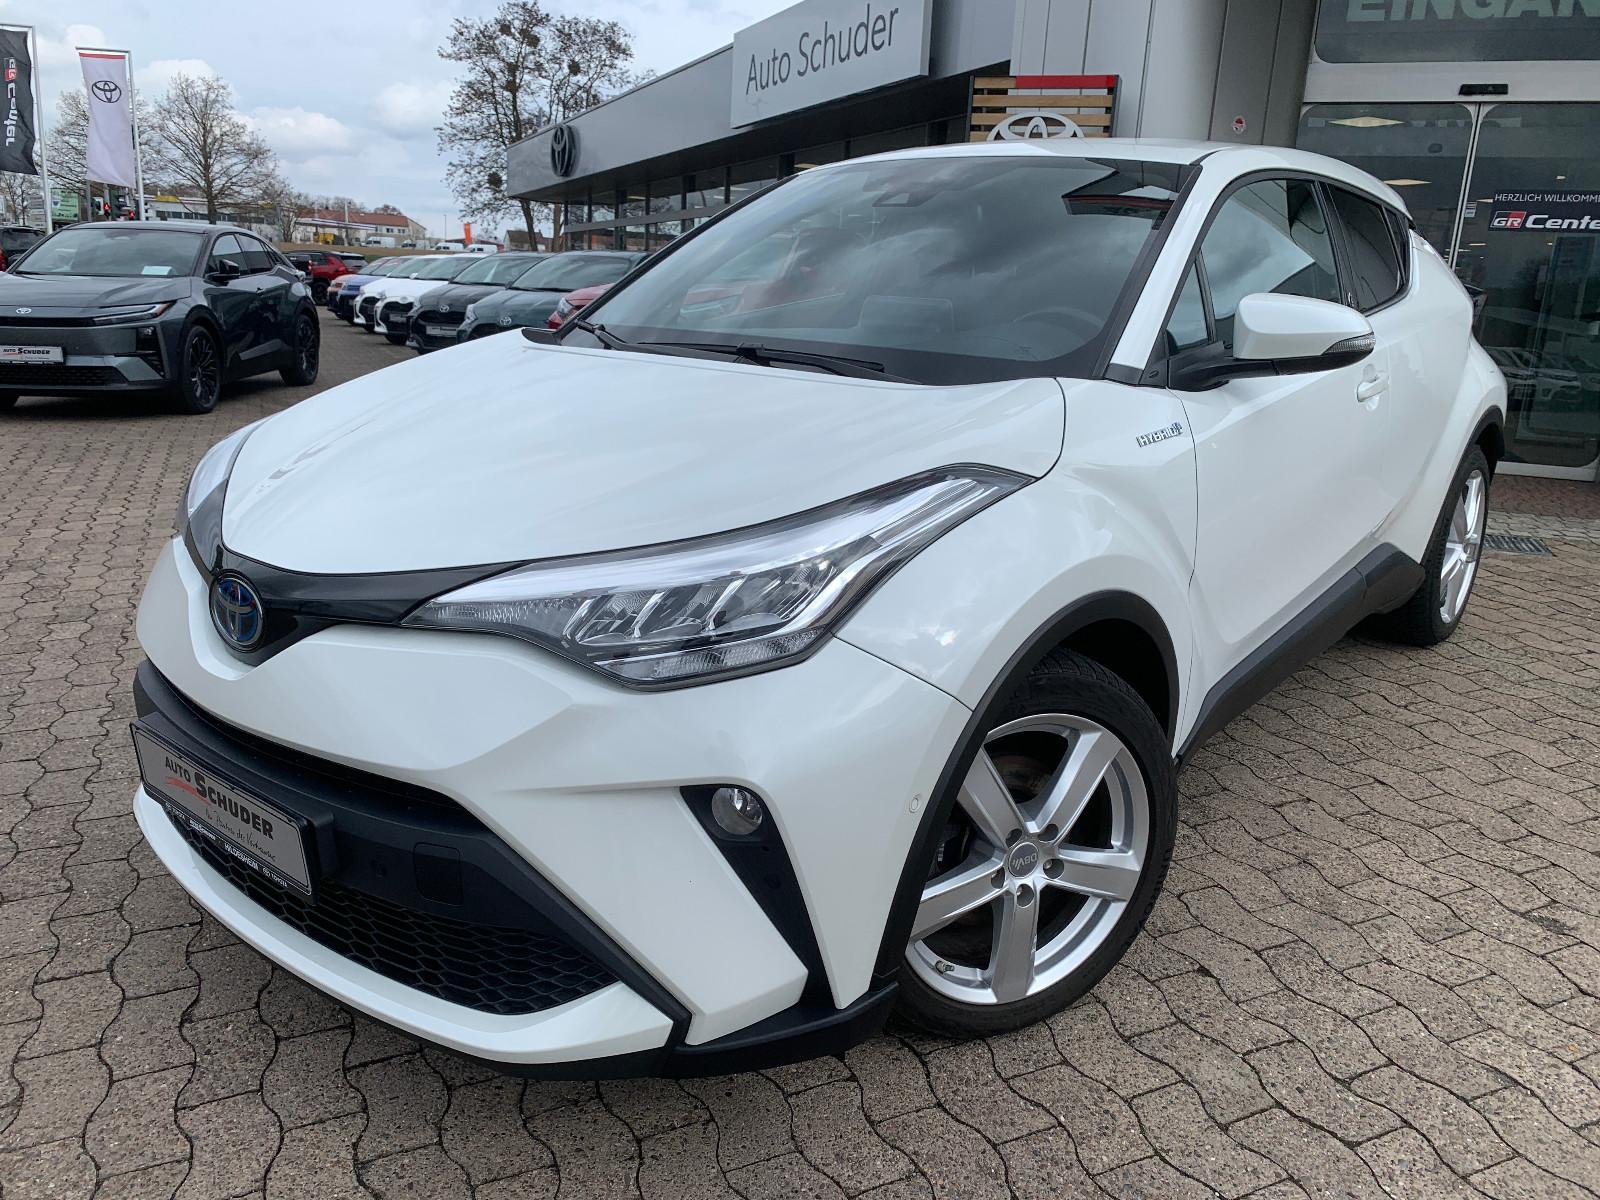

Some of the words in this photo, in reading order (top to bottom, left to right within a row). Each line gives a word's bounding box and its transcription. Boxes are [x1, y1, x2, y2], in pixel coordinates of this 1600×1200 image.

[745, 48, 791, 95] Auto
[797, 3, 899, 77] Schuder
[1494, 193, 1541, 202] HERZLICH
[1492, 216, 1522, 228] GR
[1525, 215, 1600, 230] Cente
[17, 347, 51, 355] SCHUDER
[1136, 425, 1179, 447] HYBRID
[165, 756, 191, 783] AUTO
[194, 771, 274, 840] SCHUDER
